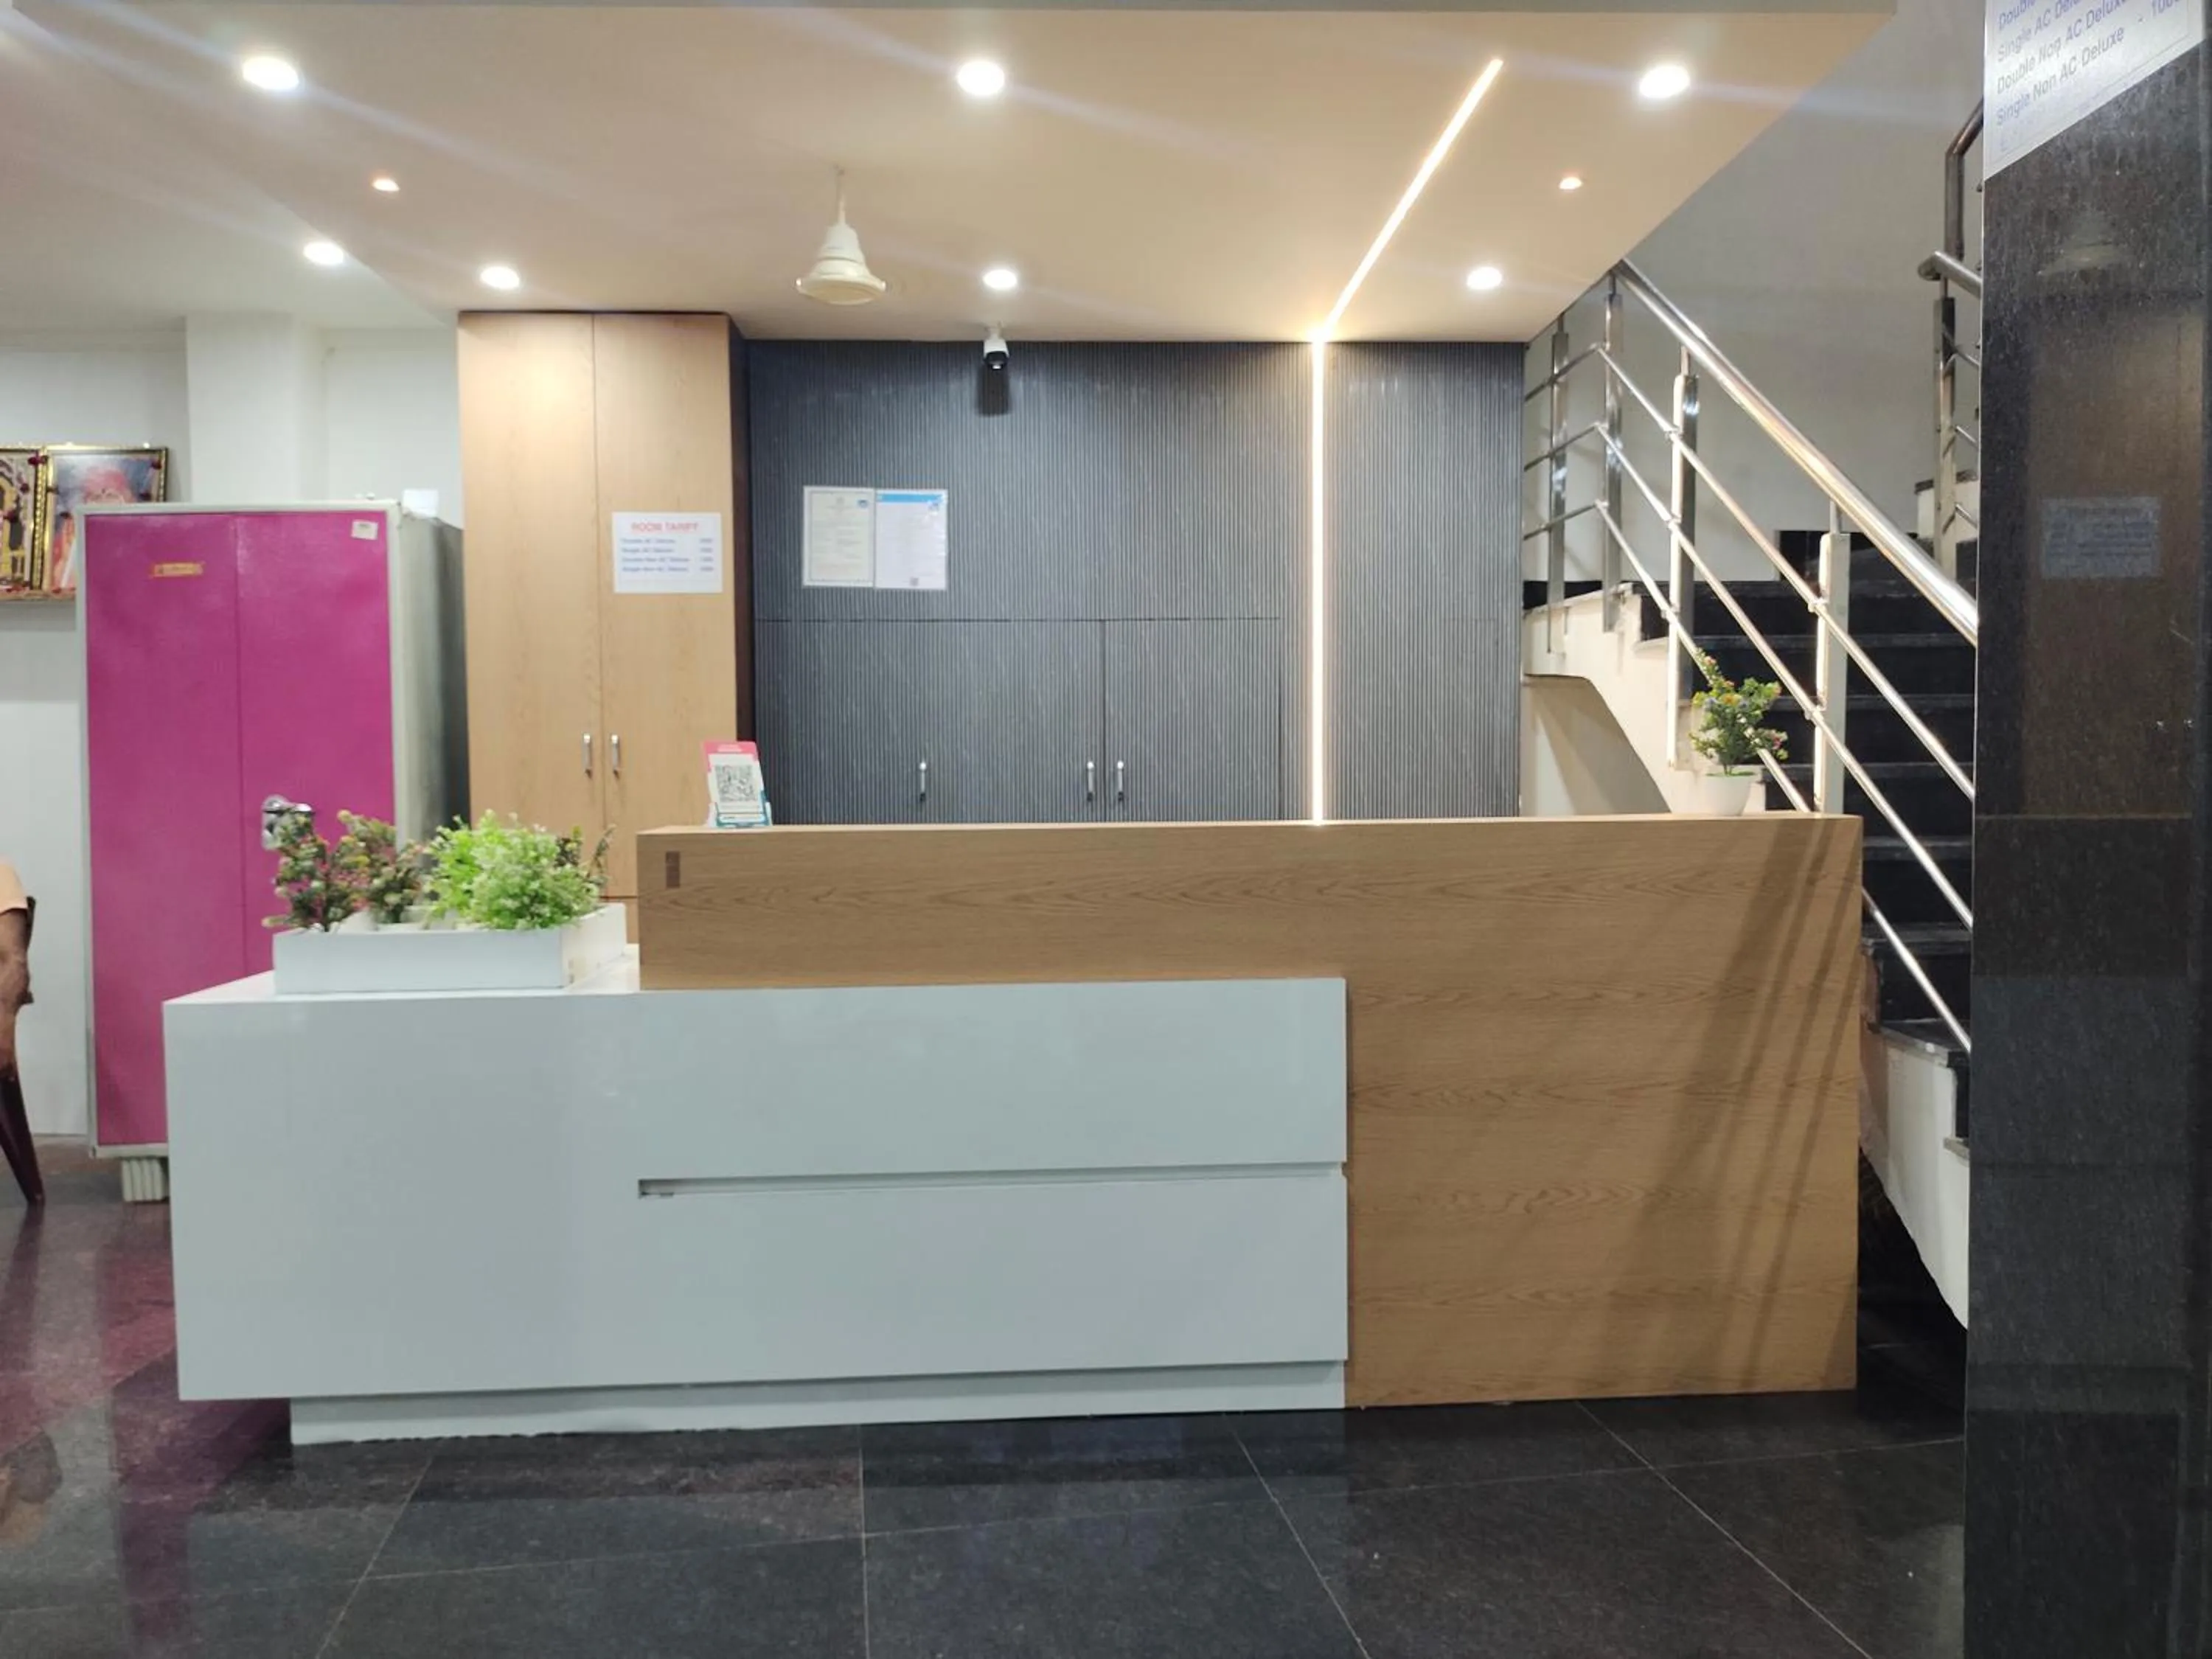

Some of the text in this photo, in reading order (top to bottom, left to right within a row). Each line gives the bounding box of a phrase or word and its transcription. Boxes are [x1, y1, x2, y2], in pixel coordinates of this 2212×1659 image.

[1997, 27, 2031, 63] Single
[2035, 8, 2051, 35] AC
[1997, 56, 2036, 94] Double
[2065, 18, 2082, 43] AC
[2086, 0, 2126, 29] Delux
[1997, 92, 2031, 125] Single
[2033, 74, 2057, 101] Non
[2059, 56, 2077, 83] AC
[2081, 27, 2124, 66] Deluxe
